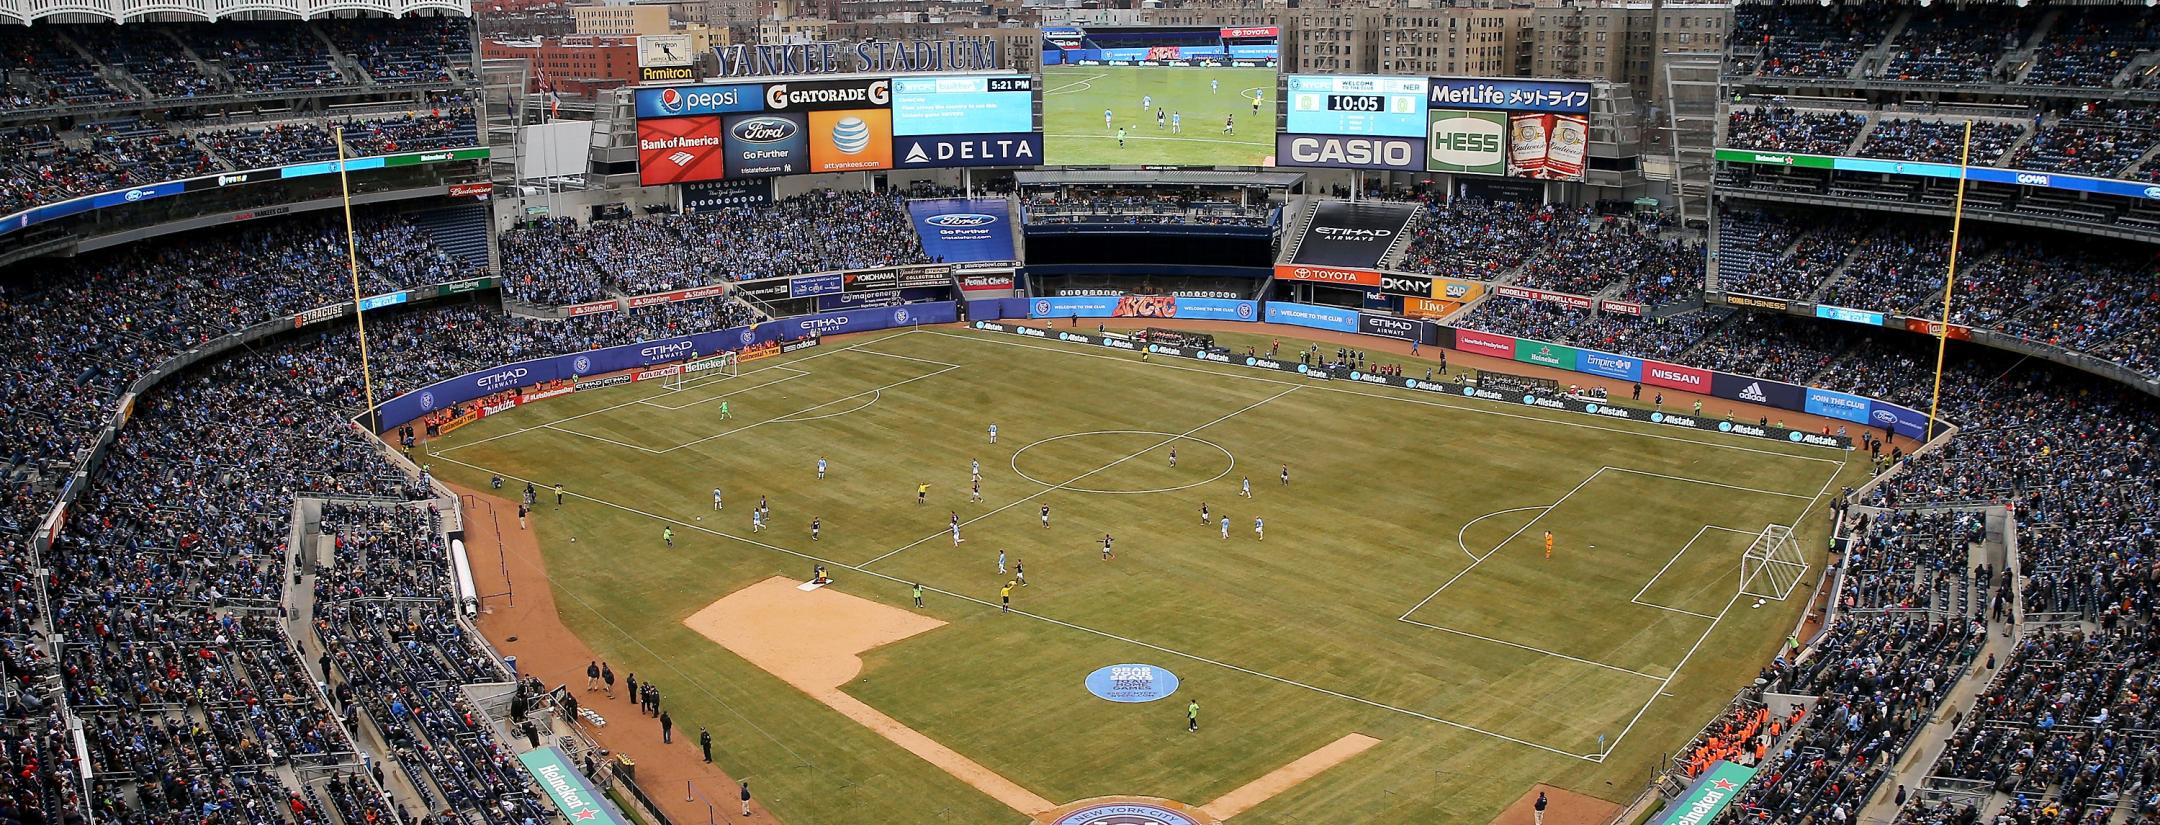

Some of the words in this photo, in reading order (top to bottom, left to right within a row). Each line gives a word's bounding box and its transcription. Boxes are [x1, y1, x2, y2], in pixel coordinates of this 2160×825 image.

[713, 42, 838, 77] YANKEE
[856, 40, 997, 72] STADIUM
[643, 67, 692, 80] Armitron
[991, 80, 1012, 90] 5:21
[1015, 80, 1029, 90] PM
[687, 88, 738, 111] pepsi
[790, 88, 866, 103] GATORADE
[1432, 84, 1504, 104] MetLife
[1509, 89, 1588, 107] メットライフ
[1334, 95, 1378, 111] 10:05
[744, 120, 784, 139] Ford
[641, 139, 667, 150] Bank
[667, 137, 677, 148] of
[678, 136, 719, 148] America
[1436, 132, 1499, 152] HESS
[743, 151, 756, 160] Go
[757, 149, 788, 159] Further
[938, 140, 1033, 160] DELTA
[1291, 137, 1412, 166] CASIO
[741, 166, 781, 174] tristateford.com
[2018, 174, 2047, 185] GOYA
[449, 186, 492, 196] Budweiser
[278, 206, 290, 214] CLUB
[940, 216, 983, 225] Ford
[1315, 226, 1391, 237] ETIHAD
[856, 273, 896, 281] YOKOHAMA
[1313, 270, 1357, 281] TOYOTA
[965, 278, 987, 286] Peanut
[1381, 277, 1431, 293] DKNY
[692, 288, 719, 298] StateFarm
[1366, 291, 1385, 301] FedEx
[1446, 285, 1466, 297] SAP
[1500, 288, 1529, 298] MODELL'S
[583, 303, 613, 313] StateFarm
[1112, 295, 1178, 318] NYCFC
[1606, 303, 1636, 313] MODELL'S
[1744, 298, 1786, 310] BUSINESS
[302, 304, 343, 322] SYRACUSE
[1281, 310, 1308, 319] WELCOME
[1328, 315, 1343, 323] CLUB
[801, 317, 848, 329] ETIHAD
[984, 322, 1003, 331] Allstate
[1370, 318, 1412, 330] ETIHAD
[1025, 328, 1045, 337] Allstate
[1377, 328, 1405, 336] AIRWAYS
[1067, 334, 1088, 343] Allstate
[1112, 339, 1134, 349] Allstate
[641, 340, 692, 356] ETIHAD
[797, 340, 816, 350] adidas
[652, 351, 683, 361] AIRWAYS
[1158, 346, 1181, 356] Allstate
[1206, 352, 1230, 362] Allstate
[1531, 354, 1559, 364] Heineken
[1587, 355, 1616, 368] Empire
[685, 359, 726, 373] Heineken
[1255, 359, 1280, 369] Allstate
[477, 368, 528, 387] ETIHAD
[1307, 369, 1328, 379] llstate
[1360, 373, 1388, 384] Allstate
[1651, 368, 1700, 385] NISSAN
[486, 378, 518, 391] AIRWAYS
[576, 380, 601, 389] ETIHAD
[604, 376, 630, 384] ETIHAD
[1416, 381, 1444, 392] Allstate
[1474, 389, 1504, 400] Allstate
[1739, 392, 1766, 403] adidas
[1534, 397, 1565, 409] Allstate
[1811, 394, 1829, 402] JOIN
[1831, 397, 1845, 405] THE
[1846, 400, 1865, 410] CLUB
[467, 413, 477, 421] TIRE
[1597, 406, 1629, 418] Allstate
[1662, 415, 1696, 427] Allstate
[1877, 413, 1893, 423] Ford
[1731, 423, 1766, 437] Allstate
[1802, 434, 1839, 447] Allstate
[538, 763, 585, 809] Heineken
[1670, 788, 1725, 825] eineken
[1074, 809, 1103, 822] NEW
[1149, 809, 1180, 822] CITY
